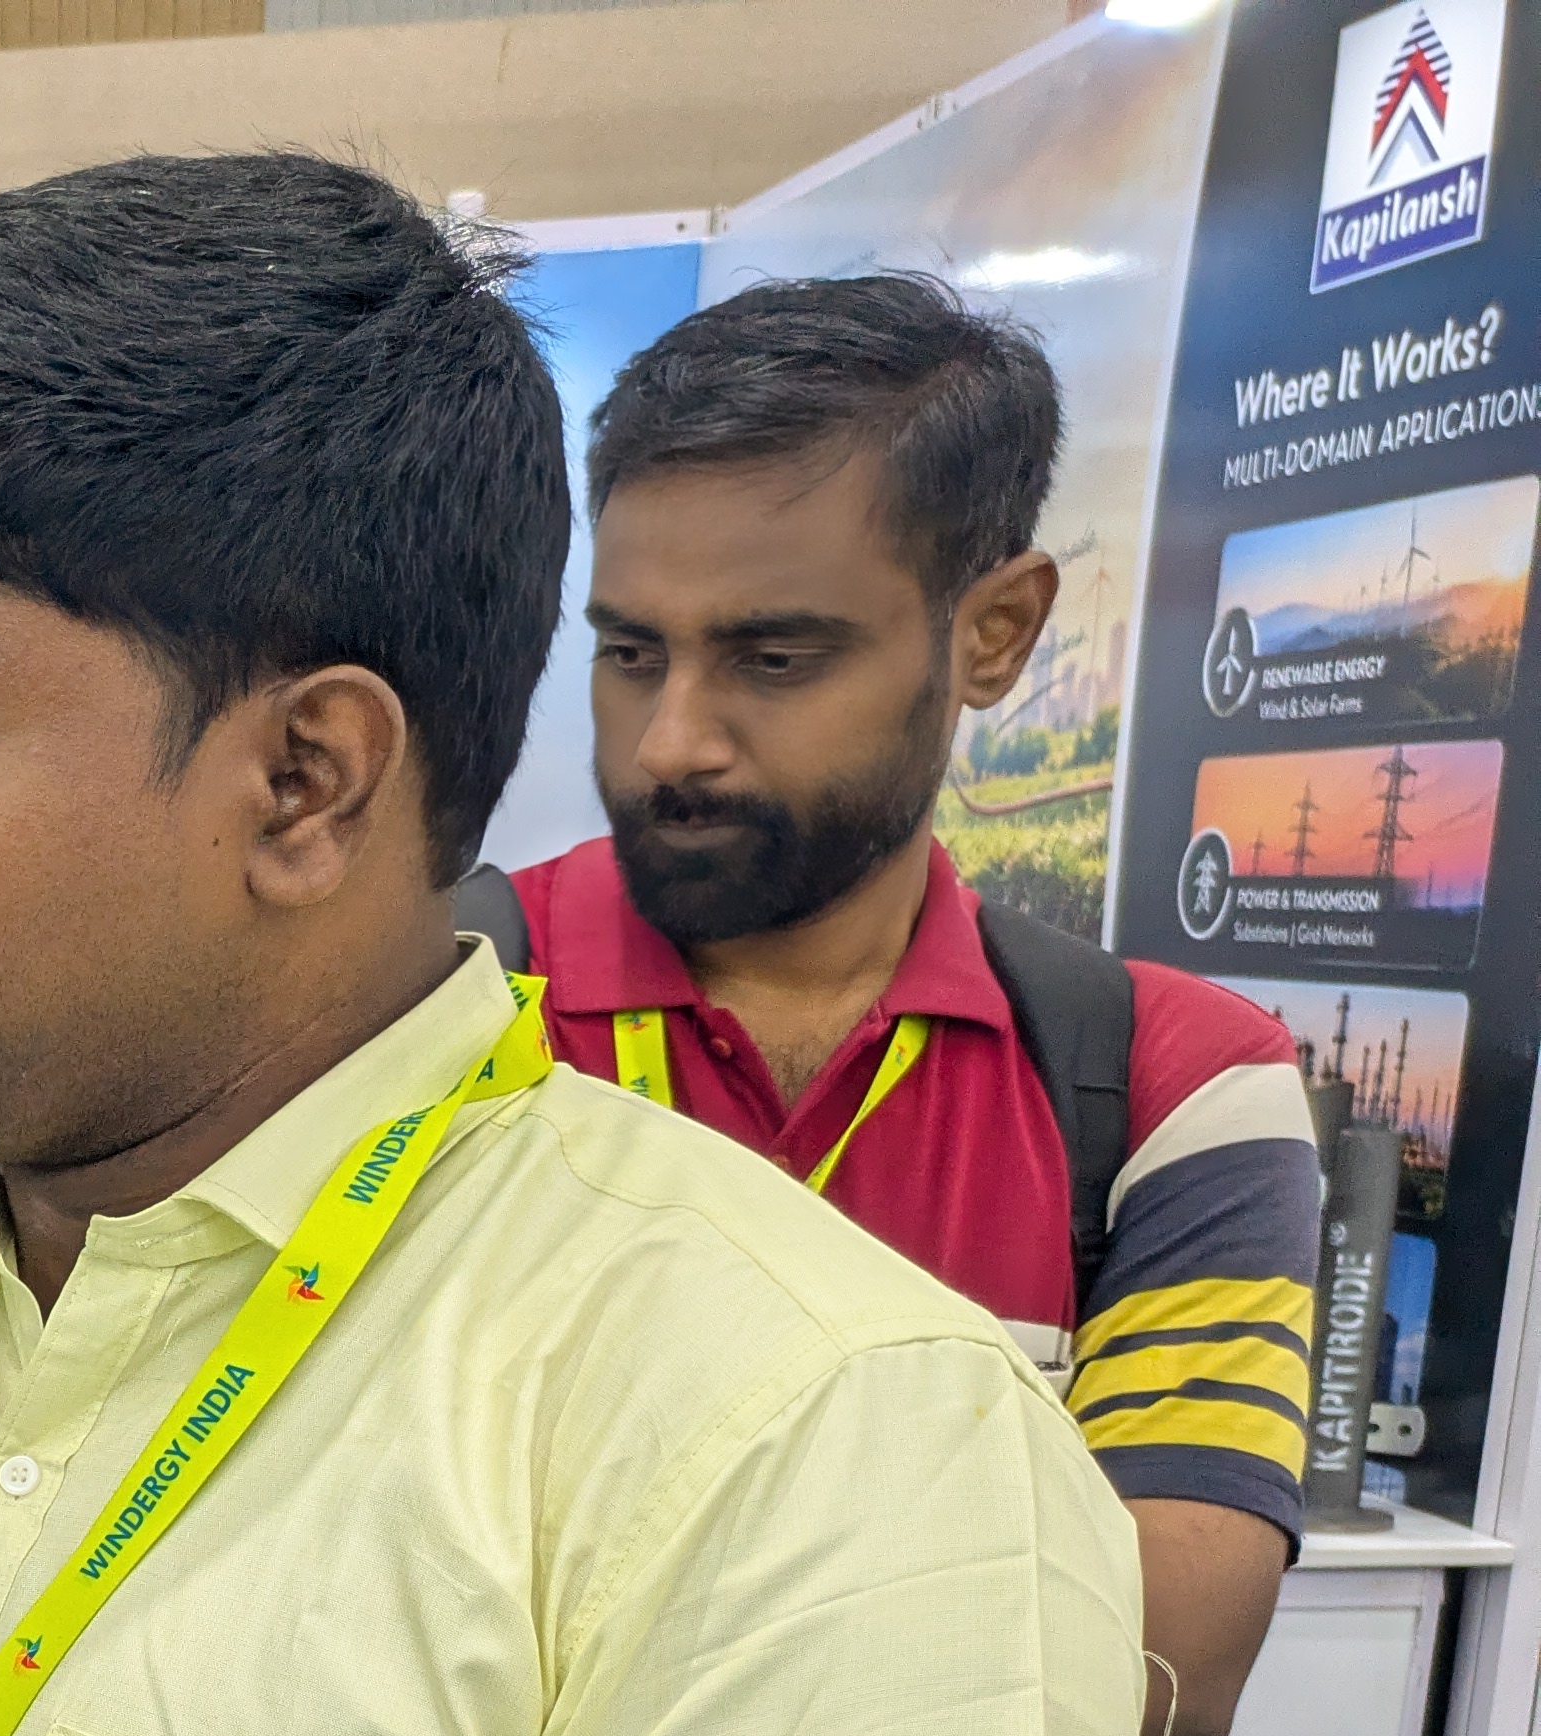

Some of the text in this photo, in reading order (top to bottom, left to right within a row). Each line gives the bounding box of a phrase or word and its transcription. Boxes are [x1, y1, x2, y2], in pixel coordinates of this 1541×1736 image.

[1321, 170, 1476, 264] Kapilansh
[1234, 305, 1503, 427] Where It Works?
[1223, 424, 1373, 491] MULTI-DOMAIN
[1334, 655, 1387, 682] ENERGY
[1312, 1252, 1373, 1472] KAPITRODE
[80, 1363, 255, 1583] WINDERGY INDIA
